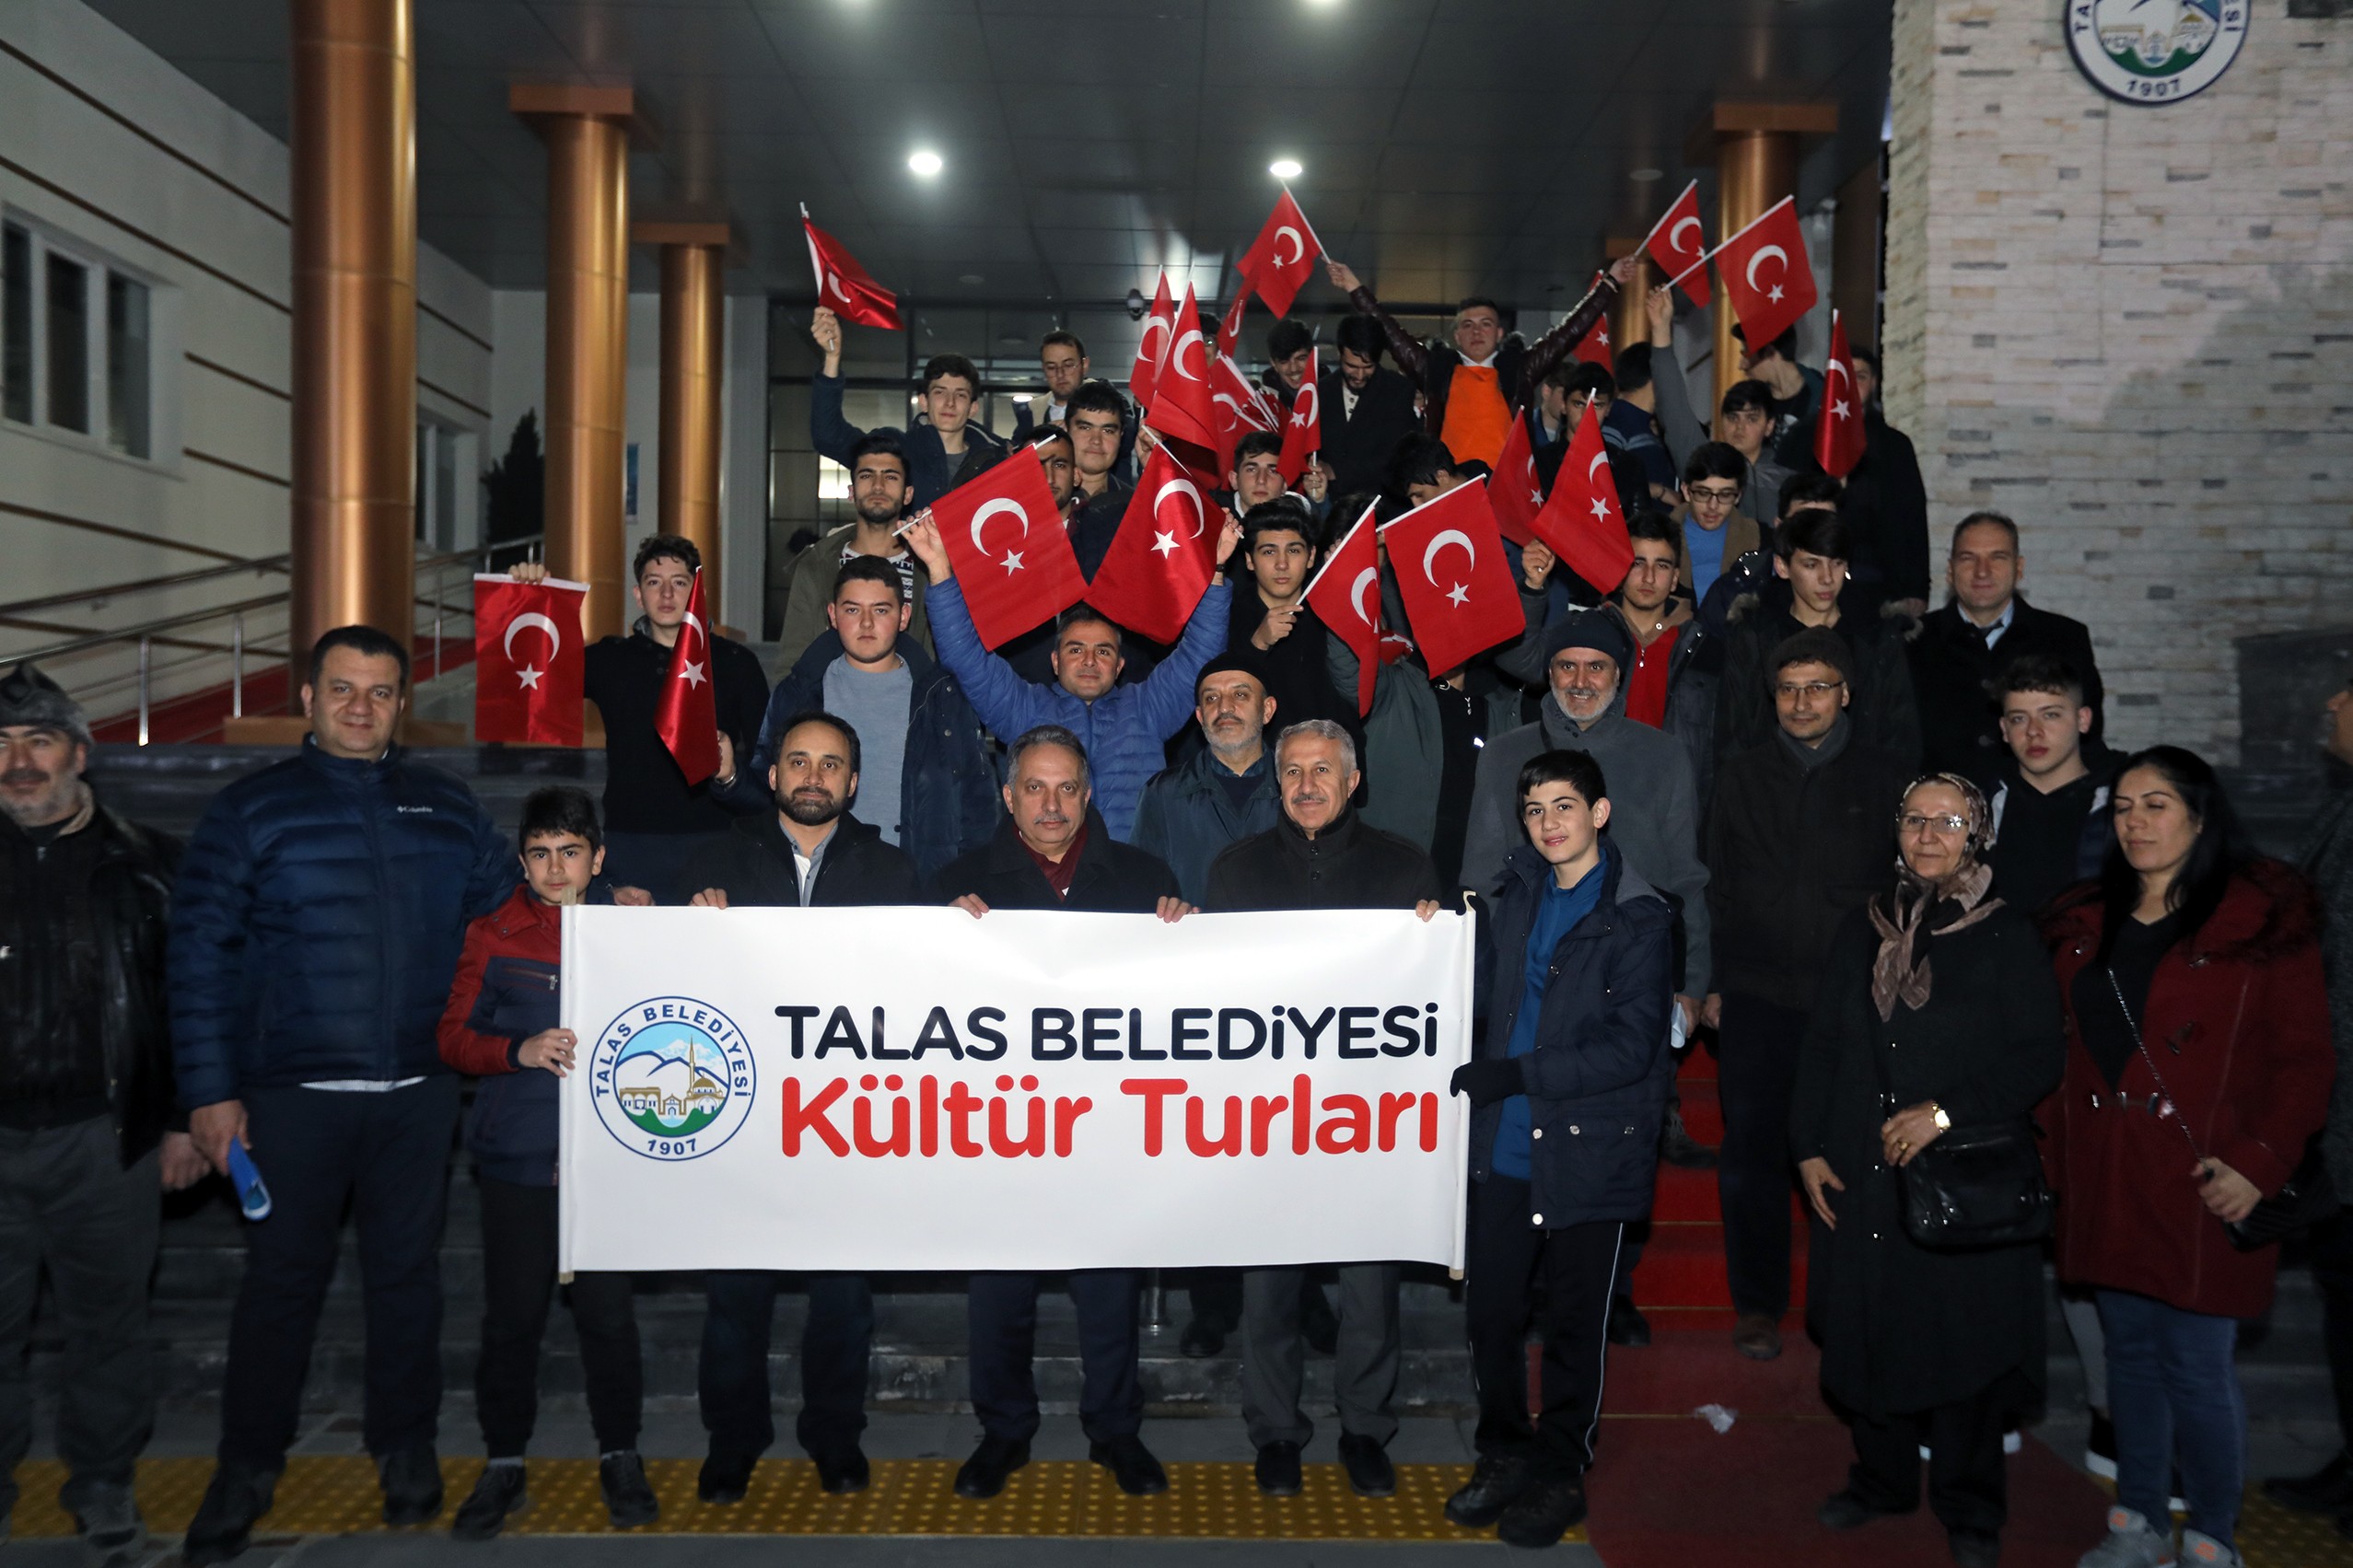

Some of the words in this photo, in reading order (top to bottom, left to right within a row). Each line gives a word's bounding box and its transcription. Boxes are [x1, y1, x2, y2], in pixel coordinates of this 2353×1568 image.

[2128, 78, 2180, 96] 1907
[597, 1023, 632, 1098] TALAS
[775, 1006, 1008, 1061] TALAS
[783, 1074, 1093, 1158] Kültür
[1121, 1074, 1439, 1157] Turları
[647, 1138, 697, 1155] 1907
